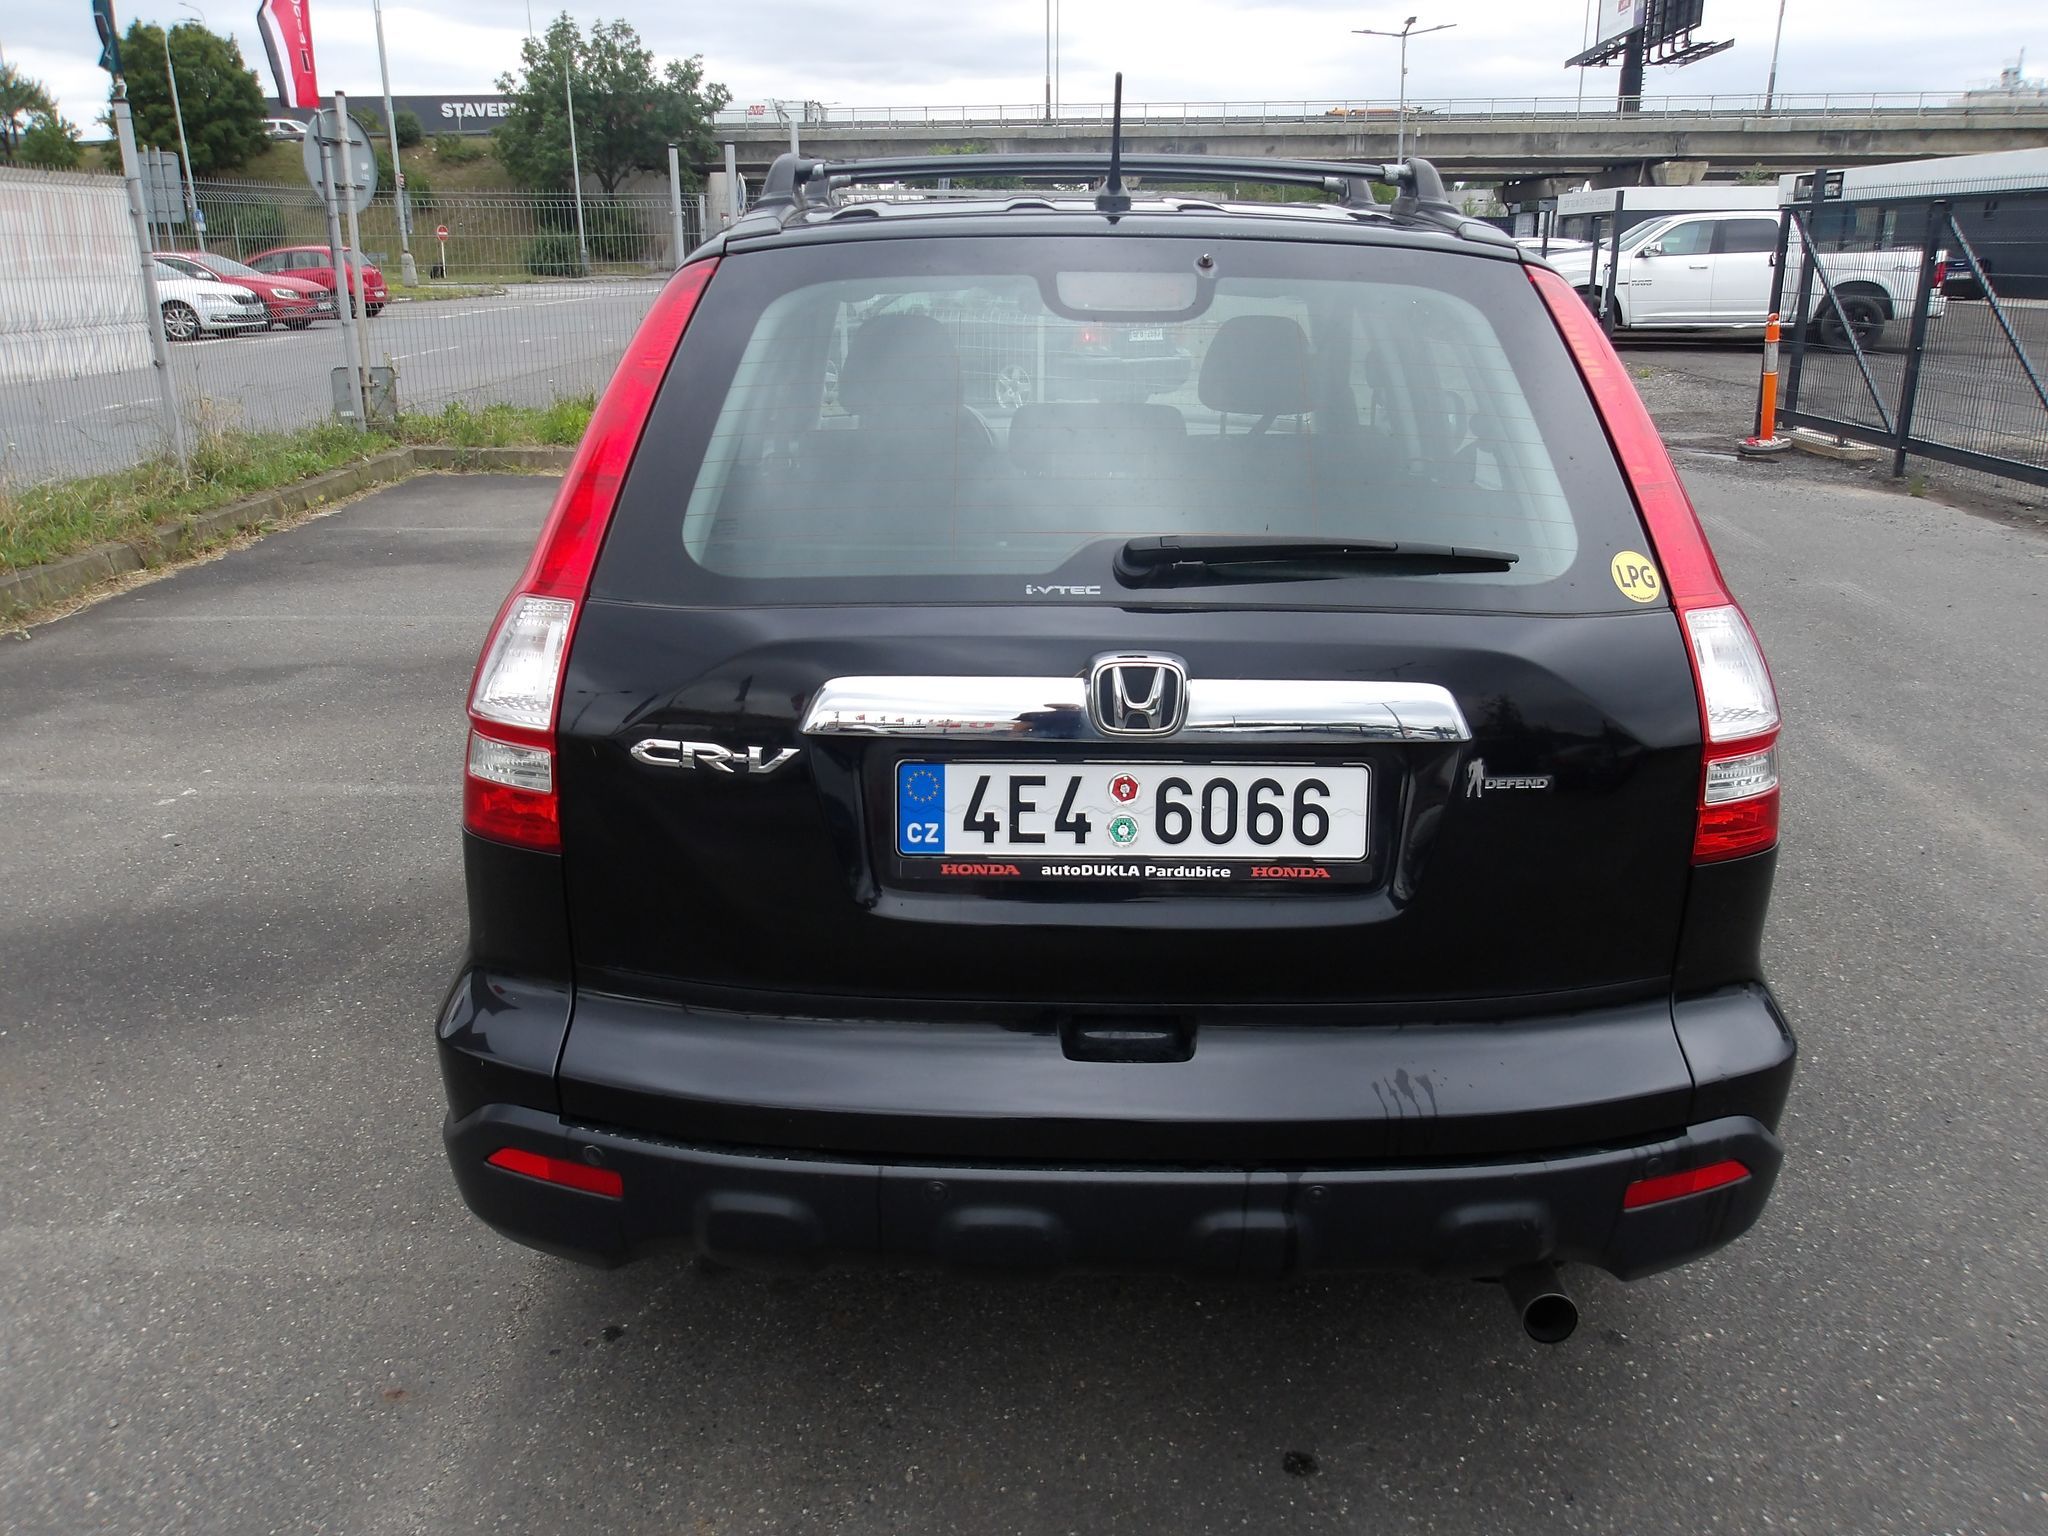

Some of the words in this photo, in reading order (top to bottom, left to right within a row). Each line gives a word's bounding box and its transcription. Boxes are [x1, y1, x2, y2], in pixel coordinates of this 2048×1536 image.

[1615, 564, 1657, 589] LPG
[1025, 584, 1101, 595] i-VTEC
[630, 738, 801, 774] CR-V
[1484, 778, 1549, 789] DEFEND
[962, 775, 1092, 844] 4E4
[1155, 776, 1331, 846] 6066
[906, 822, 939, 843] CZ
[940, 863, 1021, 876] HONDA
[1041, 864, 1140, 877] autoDUKLA
[1144, 865, 1231, 878] Pardubice
[1250, 866, 1331, 878] HONDA
